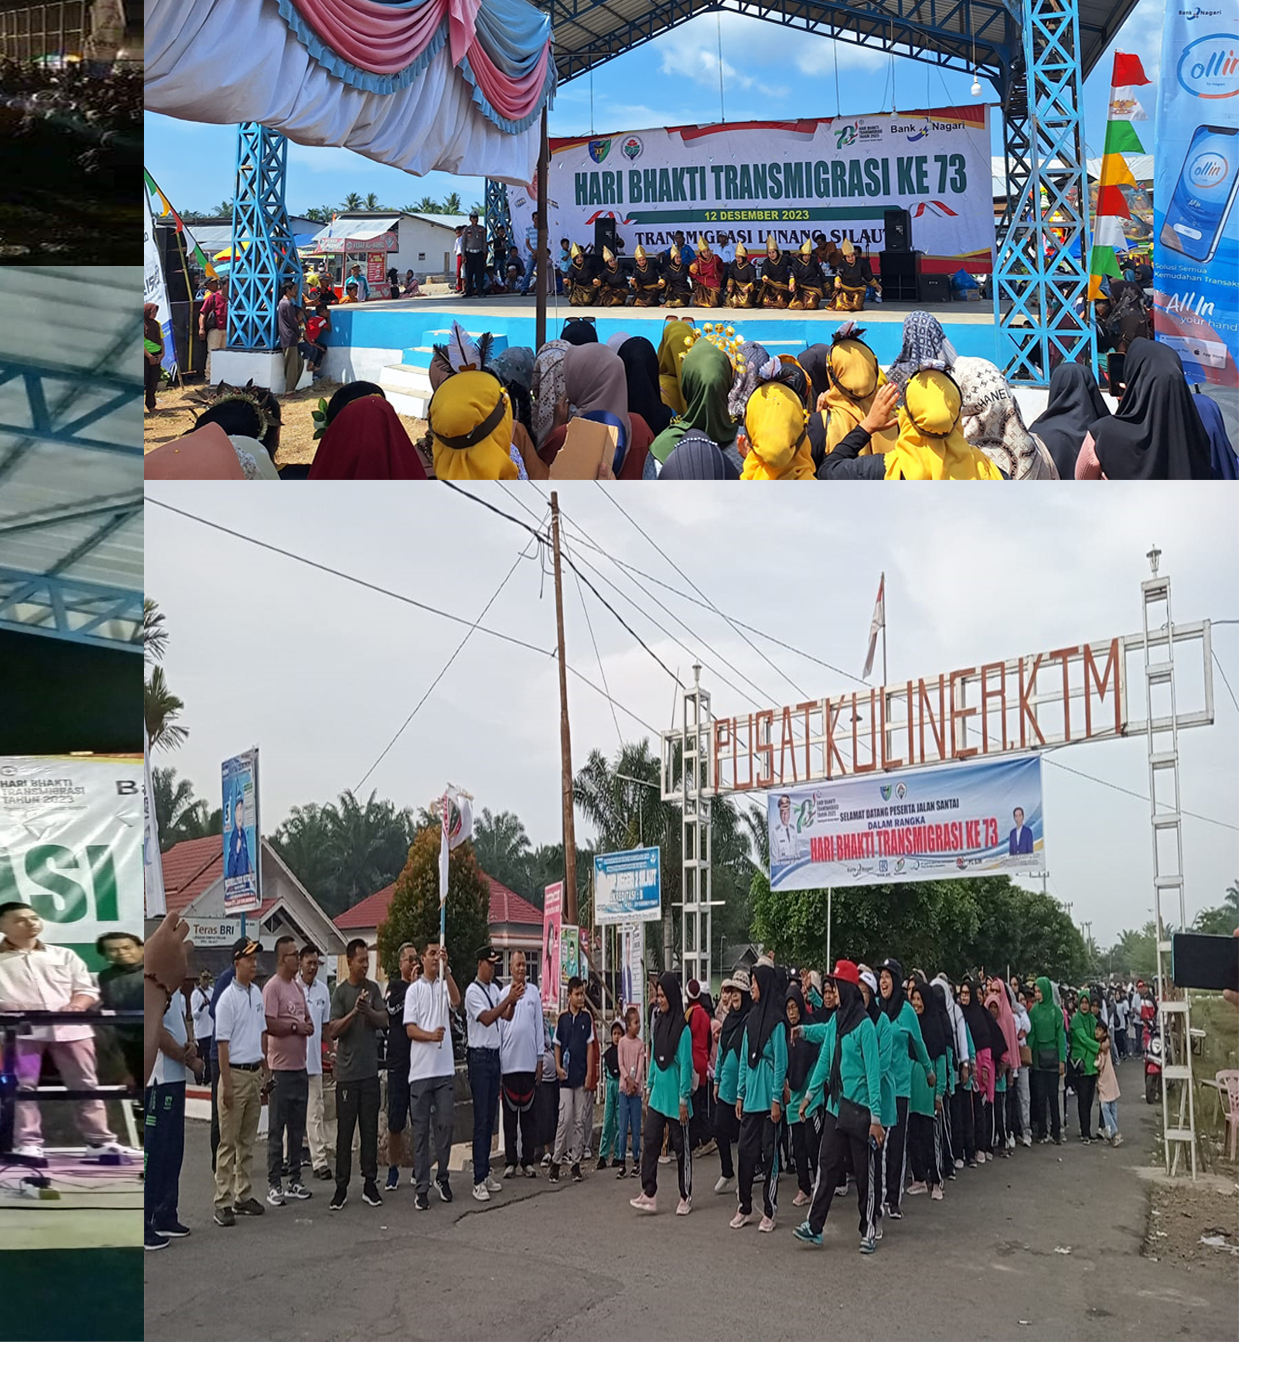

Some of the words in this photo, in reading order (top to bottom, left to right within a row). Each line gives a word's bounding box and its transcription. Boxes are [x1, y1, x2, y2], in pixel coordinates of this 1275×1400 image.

[891, 124, 916, 134] Bank
[932, 120, 965, 132] Nagari
[575, 170, 623, 206] HARI
[629, 166, 707, 204] BHAKTI
[711, 158, 891, 200] TRANSMIGRASI
[897, 155, 929, 196] KE
[934, 153, 967, 194] 73
[704, 211, 717, 221] 12
[719, 210, 779, 221] DESEMBER
[781, 209, 810, 220] 2023
[830, 228, 885, 243] SILAU
[1155, 262, 1177, 272] Solusi
[1179, 265, 1208, 274] Semua
[1153, 271, 1202, 282] Kemudahan
[1165, 292, 1195, 314] All
[1195, 295, 1215, 317] In
[1180, 316, 1205, 326] your
[1208, 318, 1239, 332] hand
[713, 701, 818, 794] PUSAT
[1018, 638, 1121, 749] KTM
[0, 780, 27, 788] HARI
[31, 778, 73, 787] BHAKTI
[2, 786, 86, 796] TRANSMIGRASI
[43, 796, 75, 804] 2023
[839, 809, 865, 822] SELAMAT
[867, 807, 889, 820] DATANG
[890, 804, 916, 816] PESERTA
[917, 801, 936, 814] JALAN
[936, 798, 959, 810] SANTAI
[868, 818, 893, 830] DALAM
[895, 816, 926, 828] RANGKA
[810, 836, 835, 862] HARI
[835, 830, 875, 860] BHAKTI
[877, 822, 963, 858] TRANSMIGRASI
[965, 820, 981, 848] KE
[983, 818, 999, 848] 73
[193, 924, 218, 935] Teras
[219, 924, 235, 936] BRI
